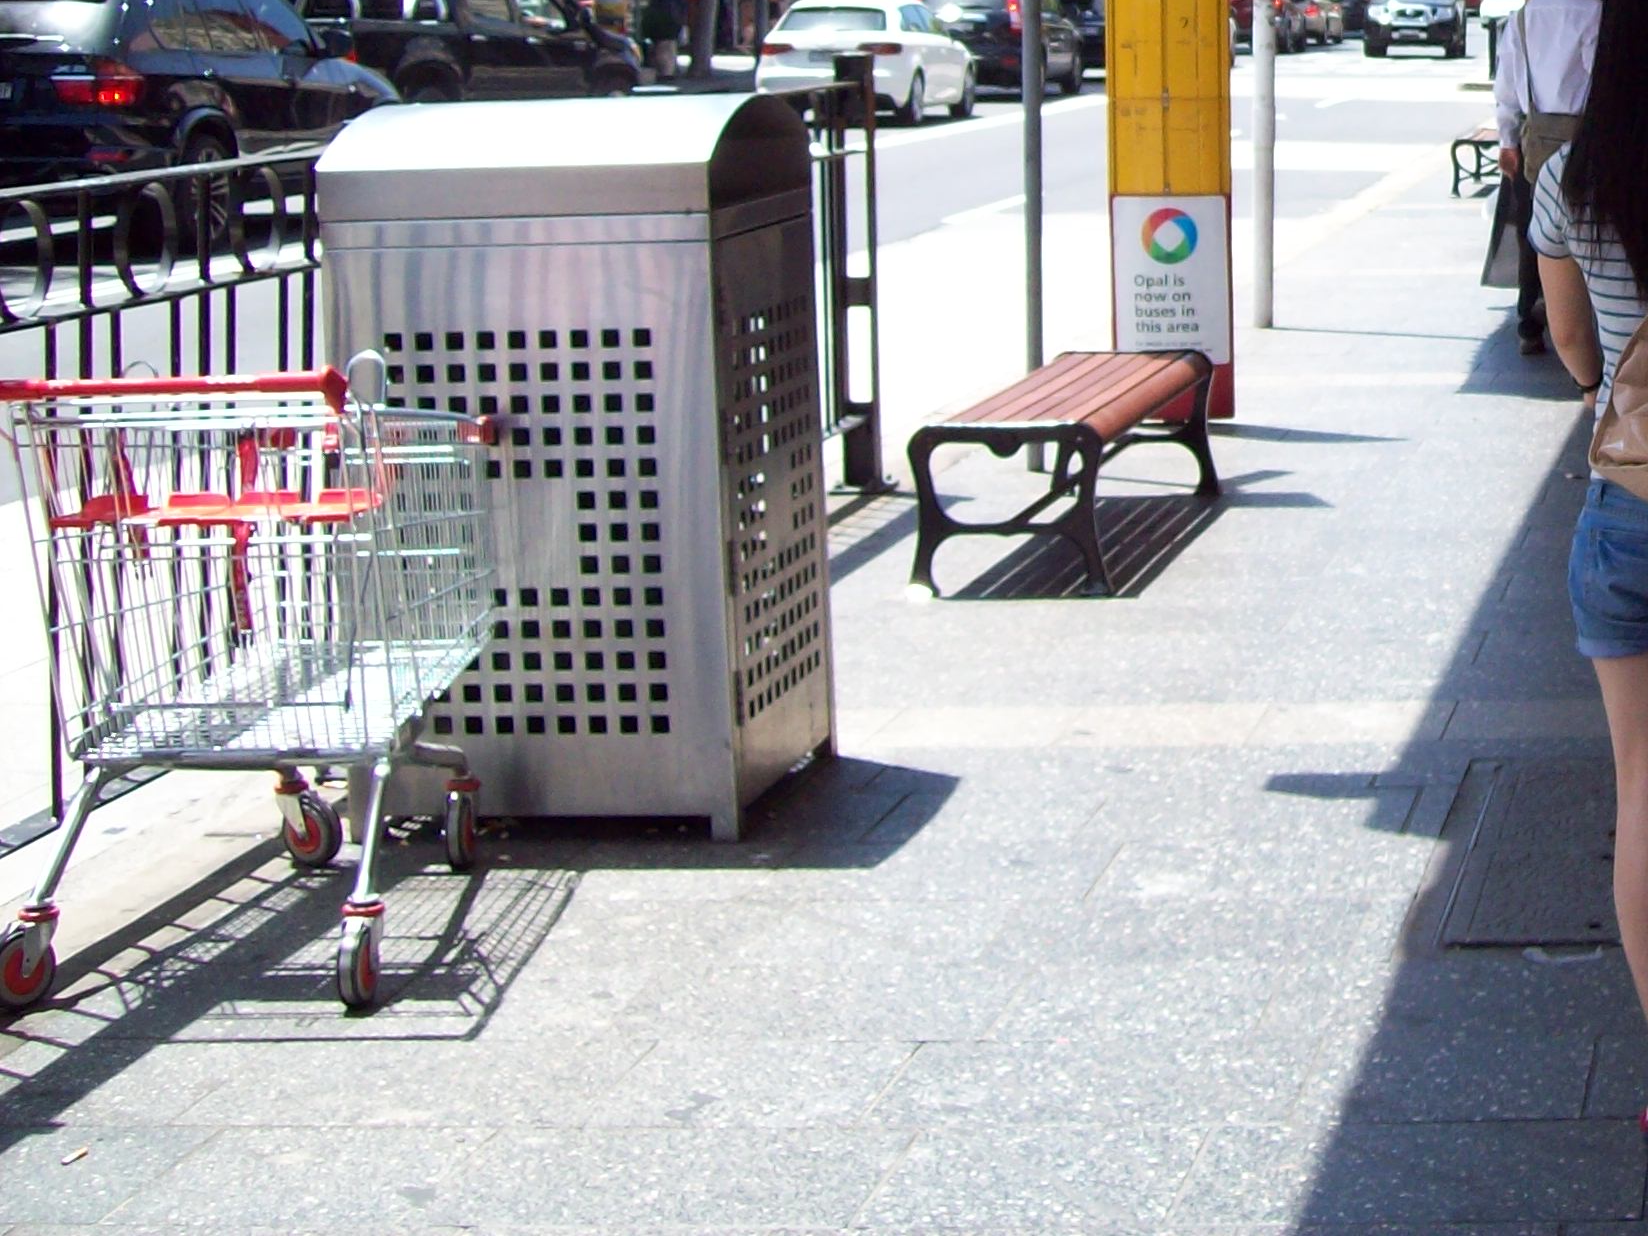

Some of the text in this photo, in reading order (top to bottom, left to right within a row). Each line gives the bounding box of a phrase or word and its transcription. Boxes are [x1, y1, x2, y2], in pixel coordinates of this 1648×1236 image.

[1134, 274, 1185, 289] Opal is
[1134, 291, 1191, 302] now on
[1135, 305, 1195, 318] buses in
[1136, 320, 1200, 333] this area
